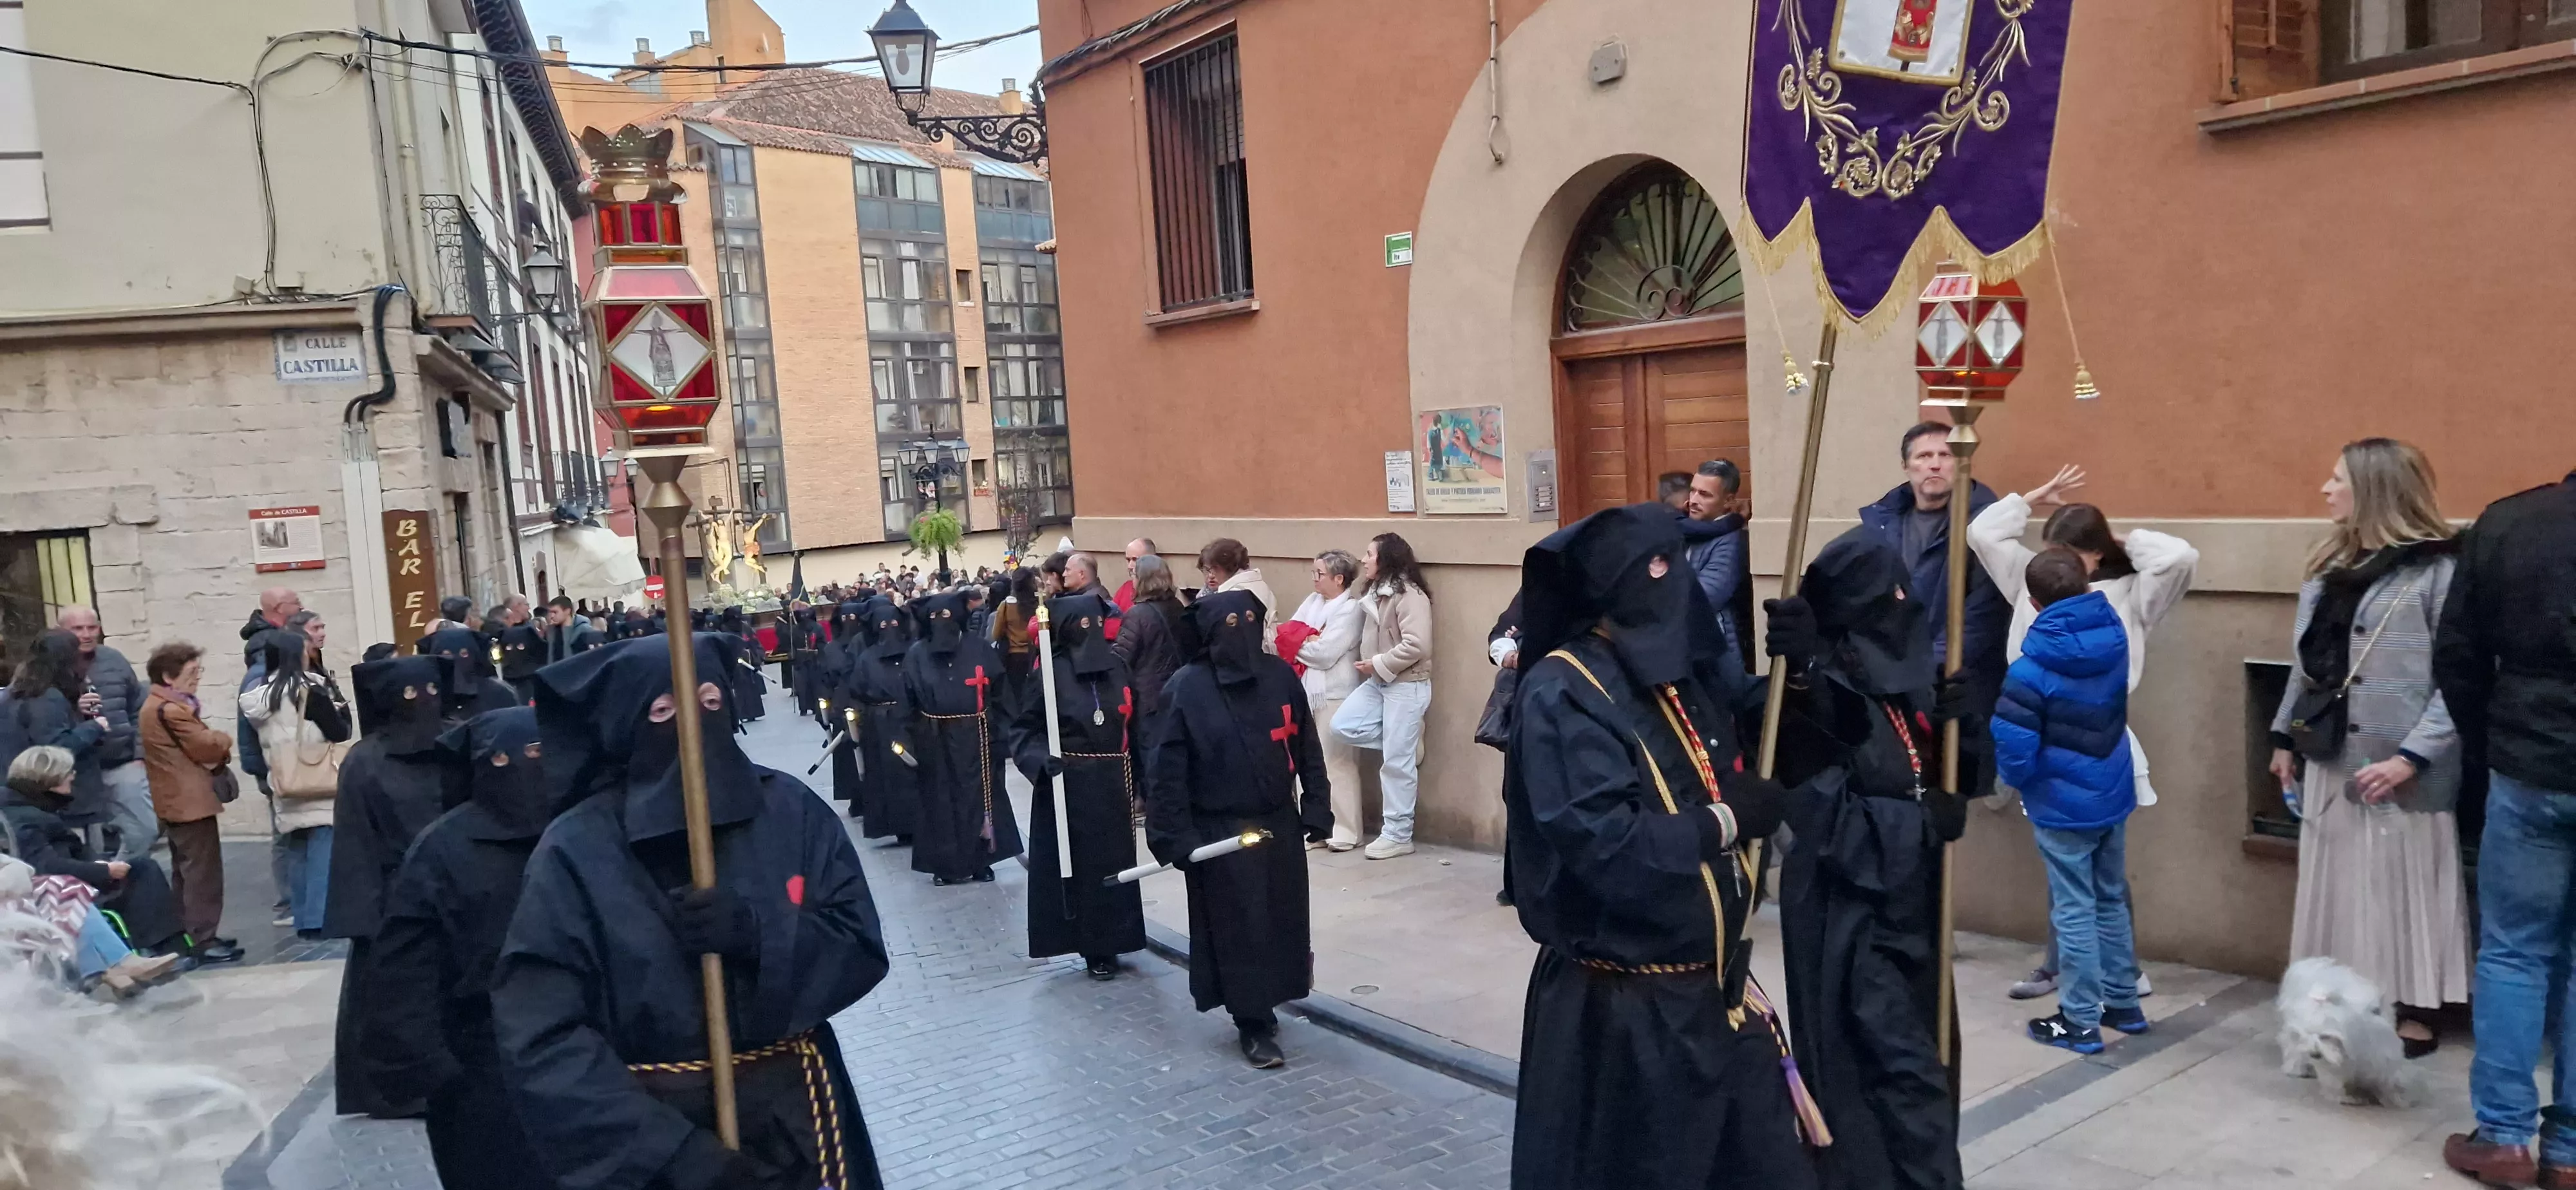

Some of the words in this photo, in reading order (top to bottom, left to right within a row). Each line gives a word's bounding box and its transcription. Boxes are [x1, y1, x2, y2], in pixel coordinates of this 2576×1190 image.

[305, 337, 346, 348] CALLE
[284, 358, 359, 373] CASTILLA
[396, 519, 422, 576] BAR
[404, 590, 426, 628] EL
